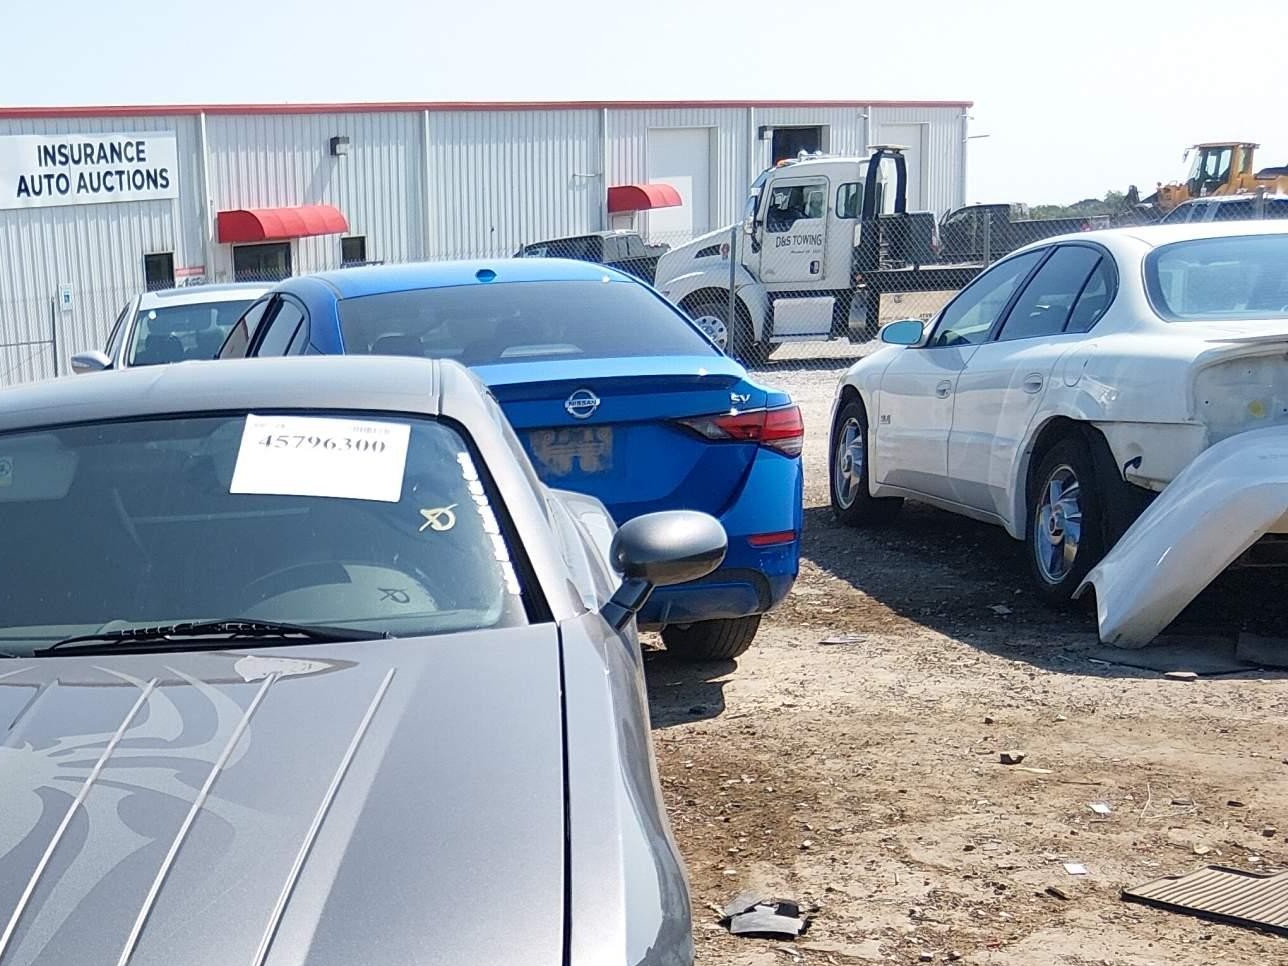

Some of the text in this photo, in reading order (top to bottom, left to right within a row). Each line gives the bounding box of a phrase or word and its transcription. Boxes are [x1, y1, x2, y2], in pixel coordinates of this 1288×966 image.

[37, 140, 146, 167] INSURANCE
[16, 167, 170, 198] AUTO AUCTIONS
[775, 233, 823, 248] D&S TOWING
[258, 434, 386, 453] 45796300
